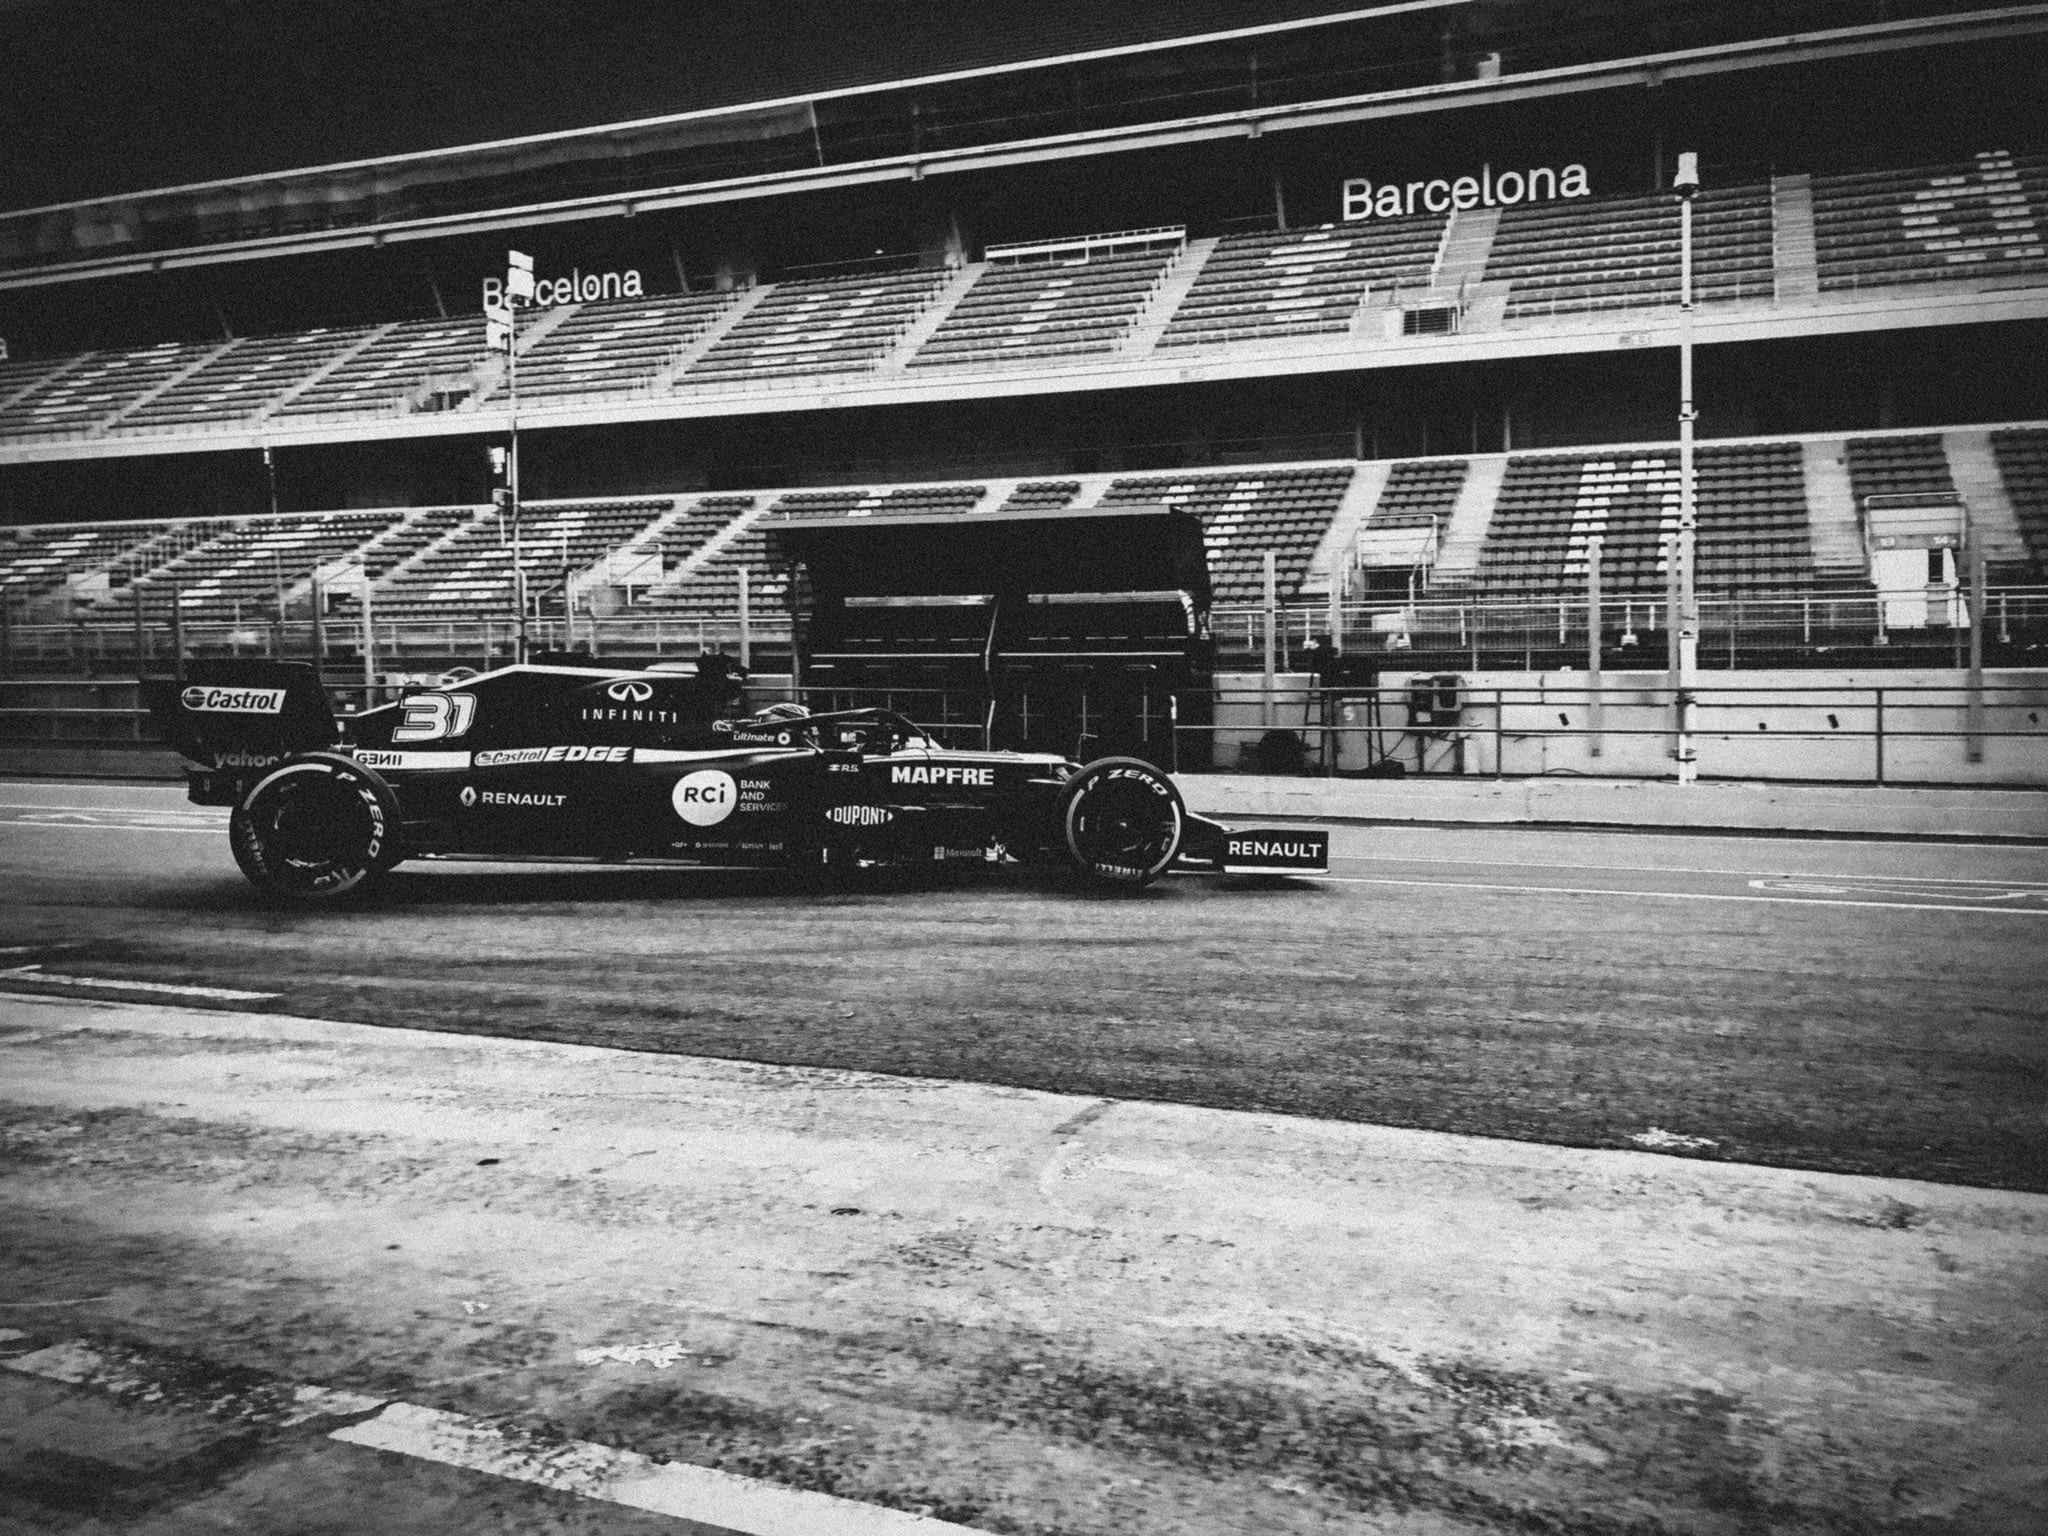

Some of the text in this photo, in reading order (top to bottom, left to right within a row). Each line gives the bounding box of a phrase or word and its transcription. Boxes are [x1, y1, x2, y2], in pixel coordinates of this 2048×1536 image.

[1343, 162, 1591, 221] Barcelona
[483, 267, 643, 311] Bcelona
[206, 689, 278, 711] Castrol
[391, 692, 477, 743] 31
[582, 708, 678, 723] INFINITI
[491, 745, 633, 764] Castrol EDGE
[740, 780, 771, 790] BANK
[891, 766, 995, 785] MAPFRE
[1107, 768, 1168, 795] ZERO
[481, 791, 568, 806] RENAULT
[740, 791, 765, 801] AND
[359, 788, 384, 858] ZERO
[834, 805, 887, 825] DUPONT
[1228, 840, 1323, 858] RENAULT
